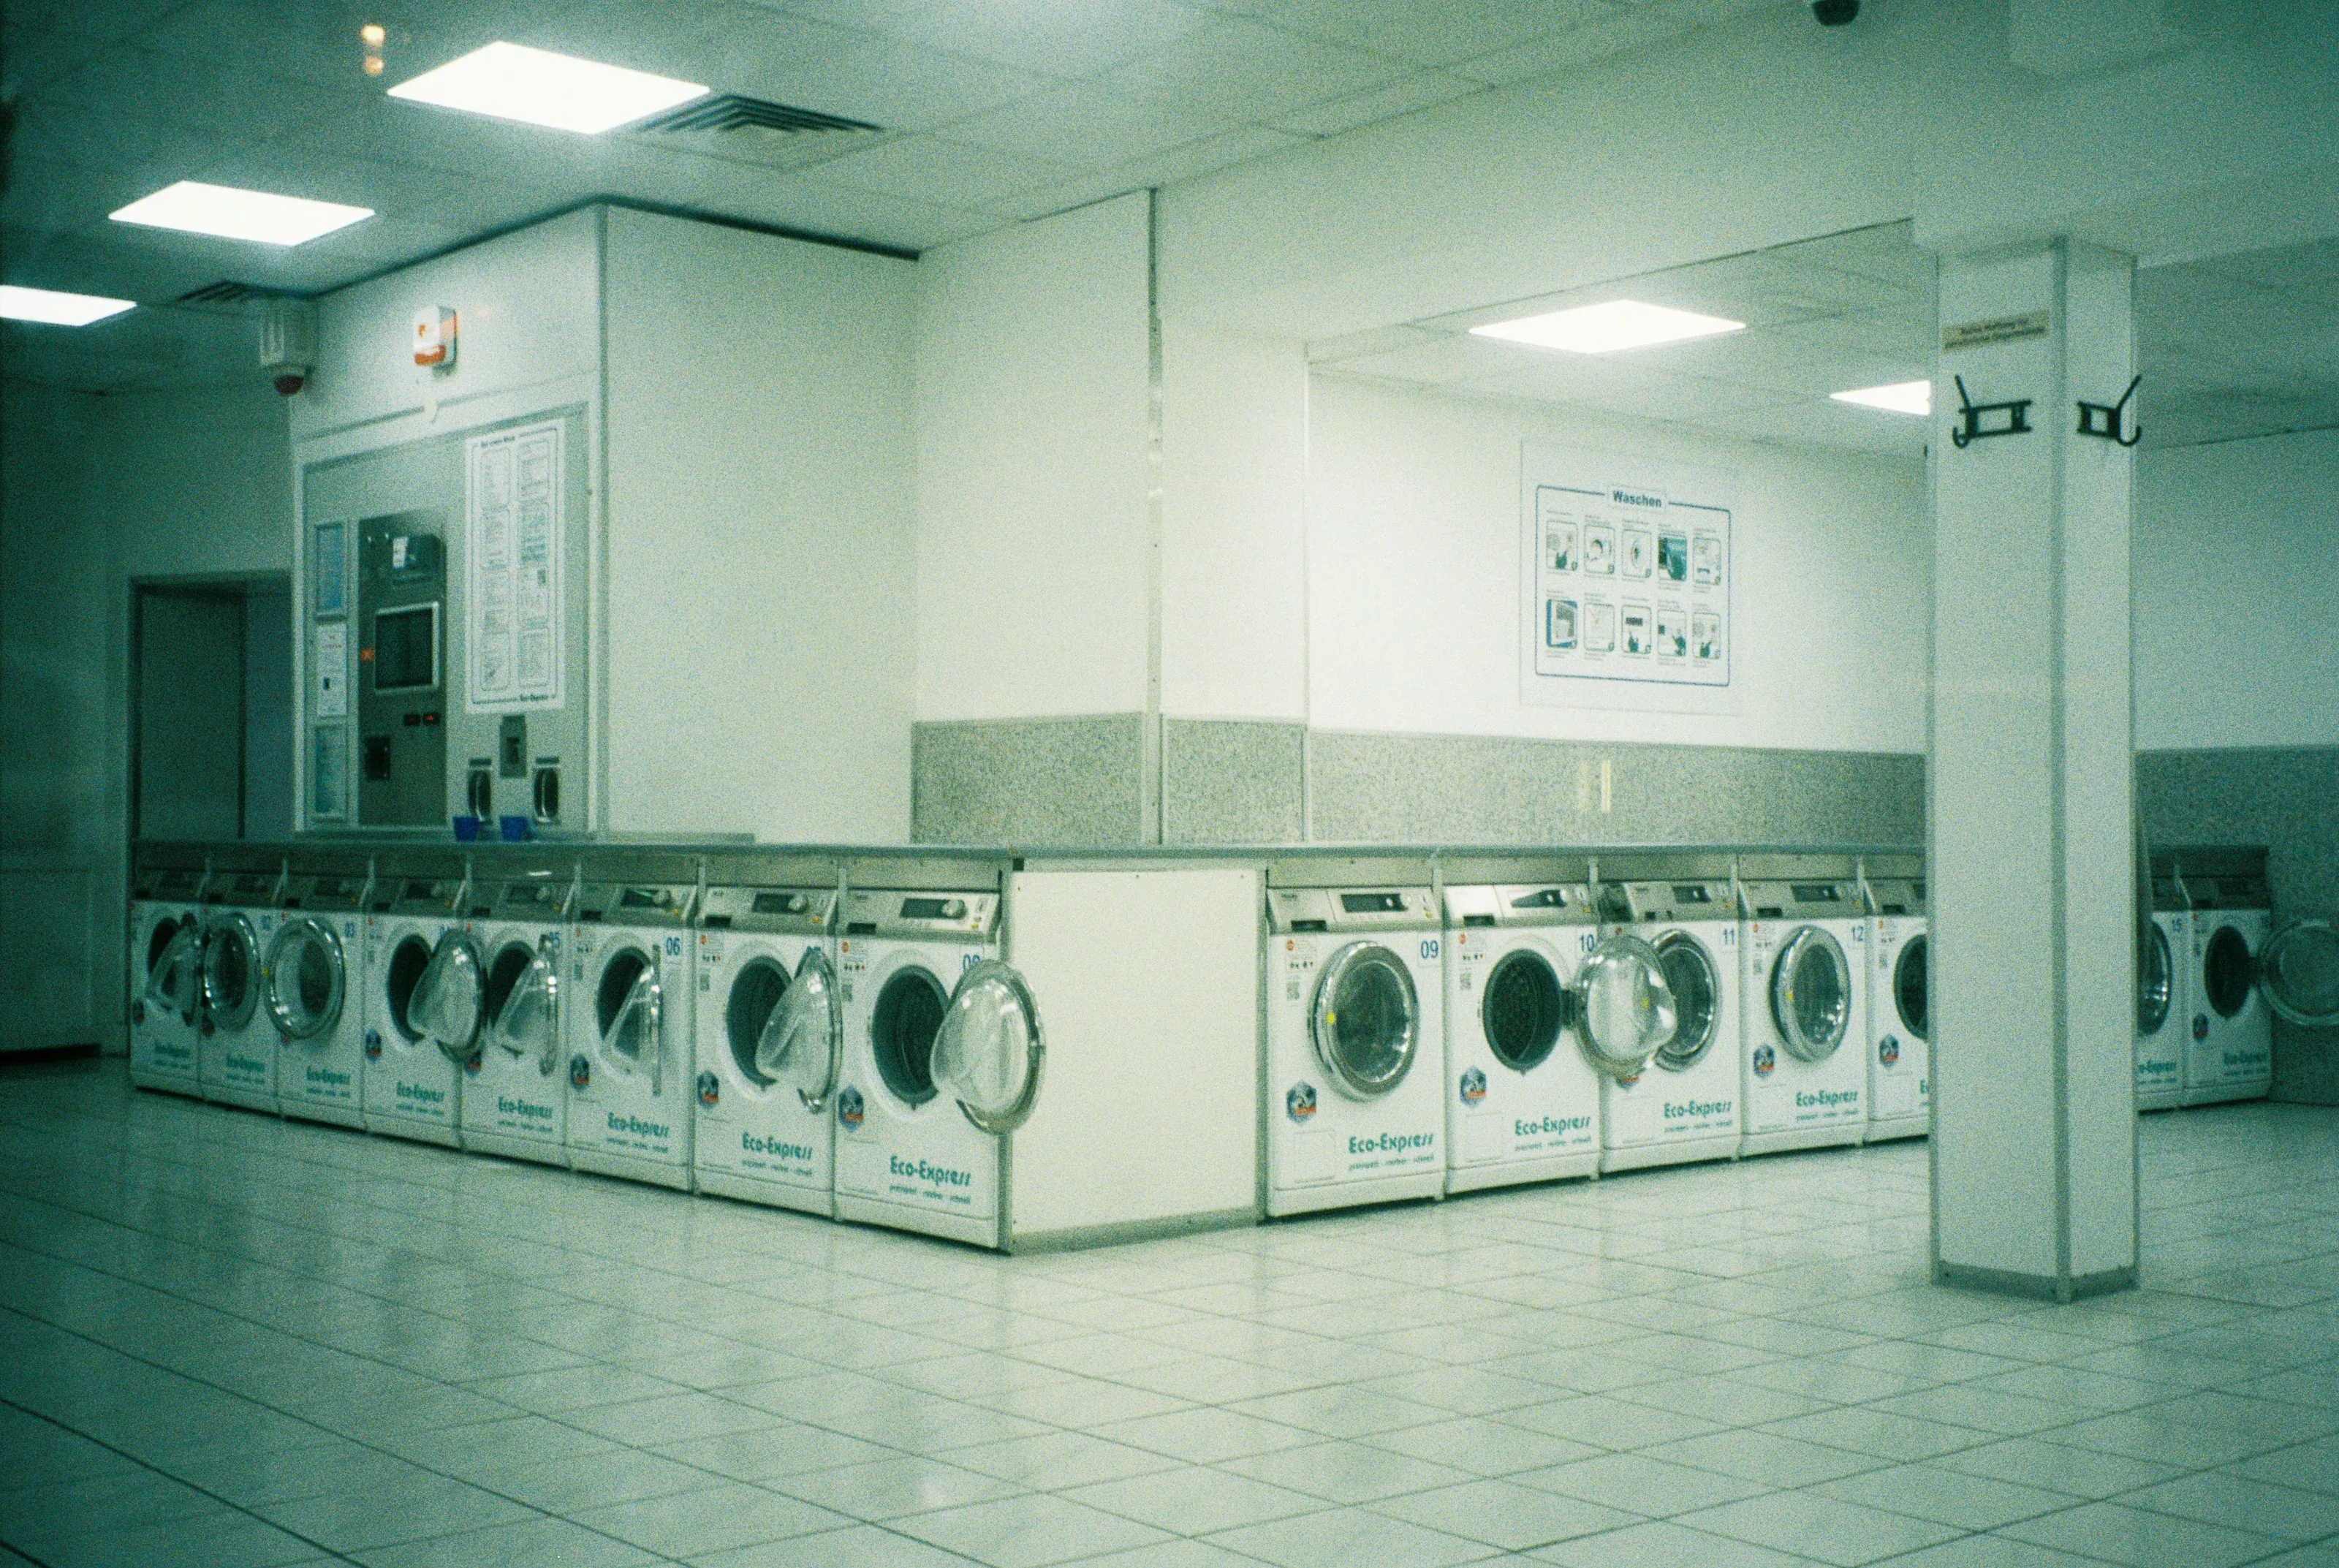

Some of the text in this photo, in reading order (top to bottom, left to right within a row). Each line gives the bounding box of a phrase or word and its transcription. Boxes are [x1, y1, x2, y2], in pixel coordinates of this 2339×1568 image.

[1613, 491, 1662, 507] Waschen
[1580, 933, 1595, 952] 10
[1722, 928, 1735, 945] 11
[1851, 925, 1864, 942] 12
[666, 936, 680, 955] 06
[1420, 939, 1438, 959] 09
[498, 1096, 552, 1118] Eco-Express
[1796, 1090, 1857, 1107] Eco-Express
[1664, 1100, 1731, 1118] Eco-Express
[607, 1112, 668, 1137] Eco-Express
[1515, 1116, 1590, 1135] Eco-Express
[743, 1132, 812, 1159] Eco-Express
[1349, 1132, 1433, 1153] Eco-Express
[890, 1156, 971, 1186] Eco-Express
